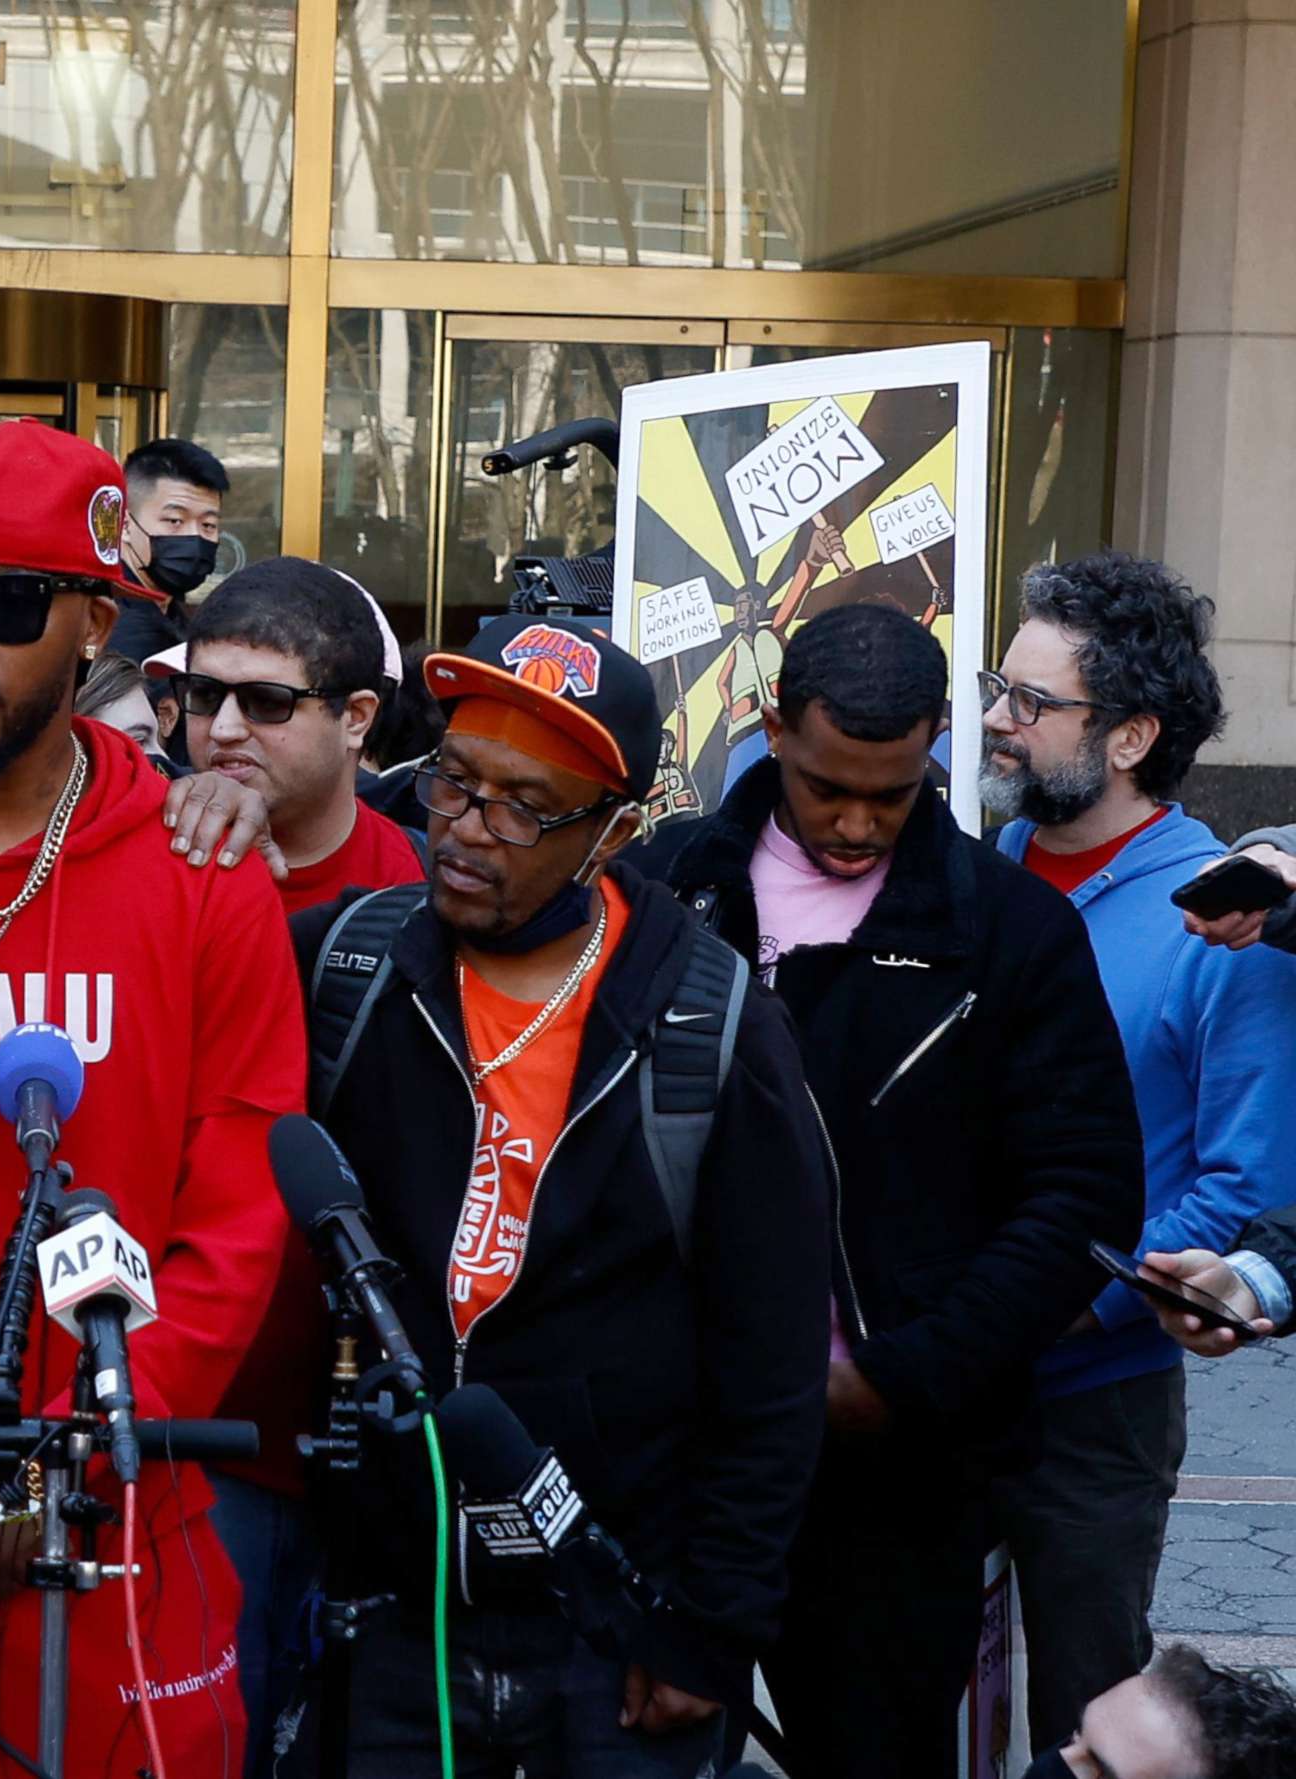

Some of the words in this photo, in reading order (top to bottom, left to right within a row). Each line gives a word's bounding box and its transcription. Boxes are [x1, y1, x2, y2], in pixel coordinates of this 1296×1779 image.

[736, 405, 840, 497] UNIONIZE
[746, 430, 865, 541] NOW
[876, 504, 917, 533] GIVE
[886, 537, 900, 554] A
[901, 514, 948, 546] VOICE
[646, 583, 701, 617] SAFE
[646, 602, 706, 636] WORKING
[642, 617, 717, 658] CONDITIONS
[48, 1233, 104, 1288] AP
[114, 1240, 147, 1283] AP
